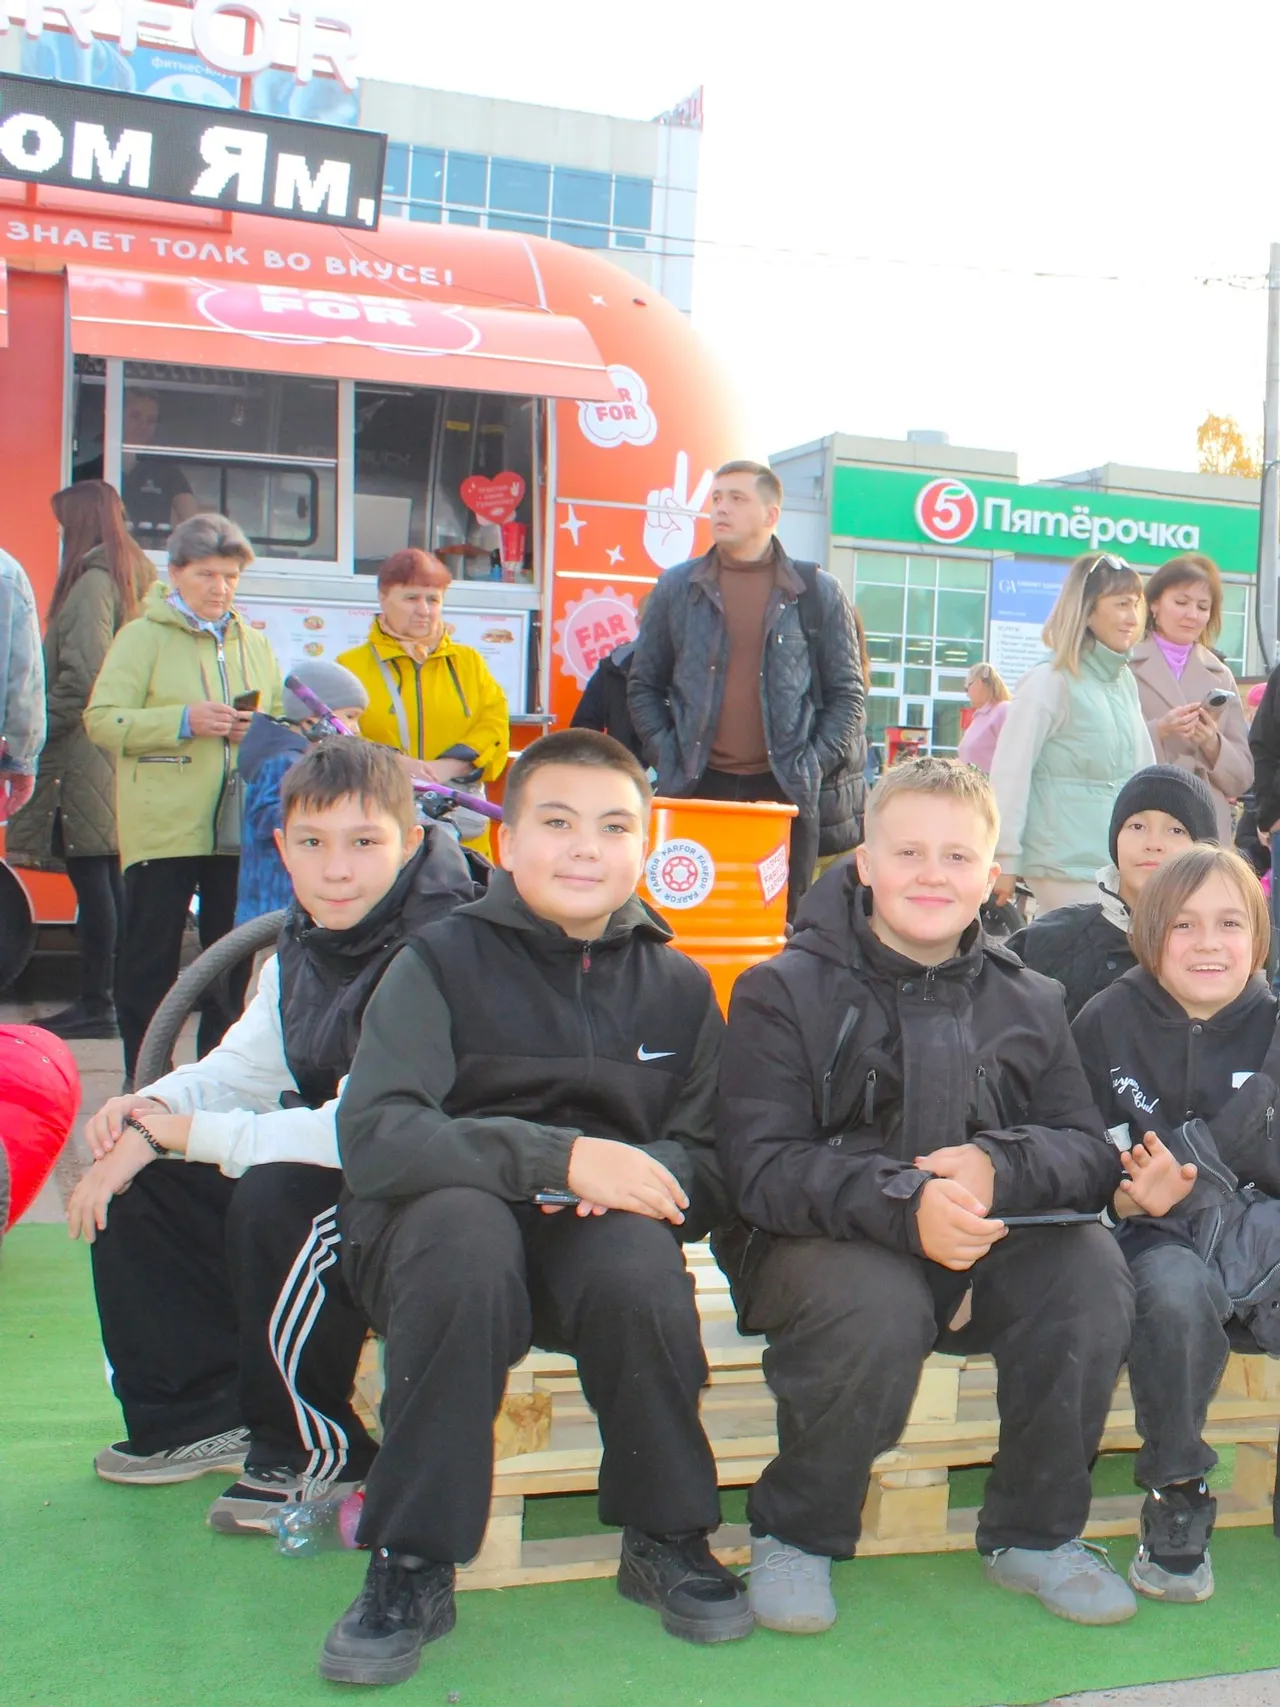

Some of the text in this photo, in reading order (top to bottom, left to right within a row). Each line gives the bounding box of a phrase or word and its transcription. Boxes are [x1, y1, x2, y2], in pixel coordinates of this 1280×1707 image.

[6, 221, 455, 287] ЗНАЕТ ТОЛК ВО ВКУСЕ!
[260, 294, 418, 328] FOR
[596, 405, 638, 422] FOR
[983, 496, 1201, 550] Пятёрочка
[574, 614, 628, 649] FAR
[662, 844, 696, 856] FARFOR
[650, 858, 662, 893] FARFOR
[697, 855, 709, 890] FARFOR
[664, 891, 699, 904] FARFOR
